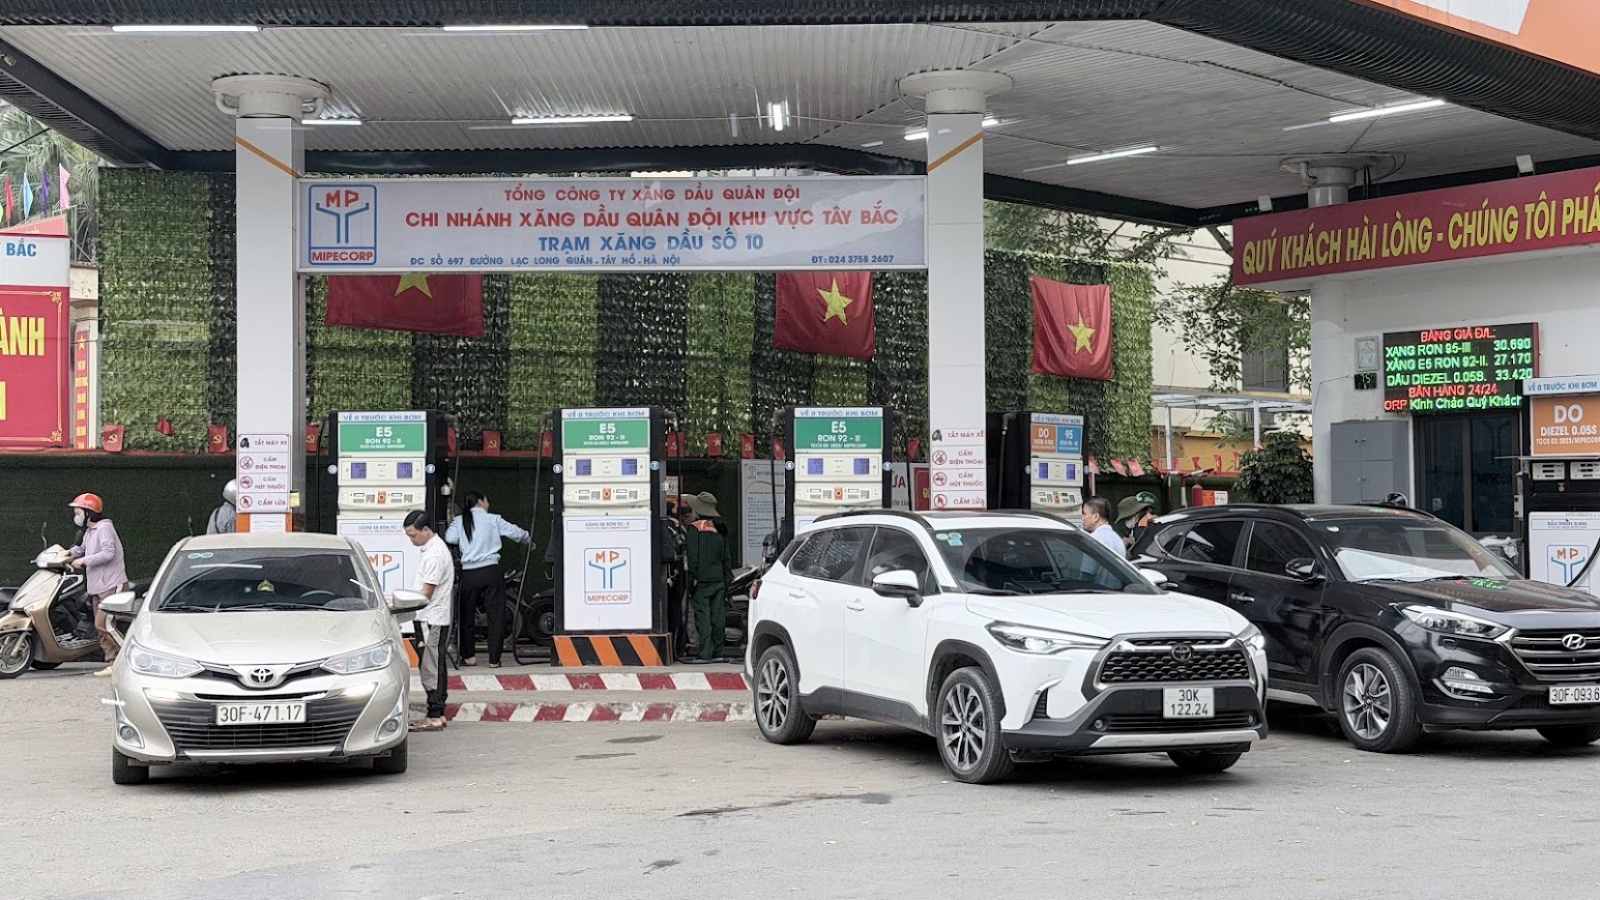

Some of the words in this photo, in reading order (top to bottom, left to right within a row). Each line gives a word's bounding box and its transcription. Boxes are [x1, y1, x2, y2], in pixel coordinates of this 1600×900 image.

[505, 183, 545, 201] TỔNG
[555, 187, 601, 201] CÔNG
[609, 189, 626, 200] TY
[632, 187, 675, 200] XĂNG
[685, 181, 713, 200] DẦU
[723, 184, 765, 200] QUÂN
[773, 184, 800, 202] ĐỘI
[405, 212, 439, 227] CHI
[447, 207, 512, 227] NHÁNH
[519, 209, 575, 227] XĂNG
[583, 203, 619, 227] DẦU
[626, 208, 679, 227] QUÂN
[688, 208, 722, 230] ĐỘI
[729, 211, 766, 226] KHU
[775, 209, 814, 229] VỰC
[823, 206, 852, 225] TÂY
[861, 200, 899, 225] BẮC
[1243, 227, 1277, 275] QUÝ
[1281, 222, 1341, 270] KHÁCH
[1346, 214, 1376, 262] HÀI
[1382, 210, 1433, 259] LÒNG
[1448, 198, 1519, 250] CHÚNG
[1525, 191, 1556, 240] TÔI
[538, 237, 590, 254] TRẠM
[600, 232, 656, 251] XĂNG
[667, 228, 703, 250] DẦU
[711, 227, 737, 250] SỐ
[745, 235, 764, 250] 10
[6, 238, 37, 257] BẮC
[312, 251, 373, 261] MIPECORP
[410, 257, 426, 265] ĐC
[430, 254, 443, 265] SỐ
[448, 257, 464, 265] 697
[470, 254, 504, 265] ĐƯỜNG
[511, 257, 530, 267] LẠC
[534, 257, 559, 265] LONG
[663, 255, 680, 266] NỘI
[872, 255, 894, 263] 2607
[1418, 344, 1443, 356] RON
[1445, 342, 1471, 354] 95-III
[1493, 338, 1531, 350] 30.690
[1418, 358, 1432, 370] E5
[1434, 356, 1460, 369] RON
[1494, 353, 1531, 366] 27.170
[1412, 372, 1452, 385] DIEZEL
[1495, 368, 1533, 381] 33.420
[1468, 383, 1498, 395] 24/24
[1410, 398, 1433, 410] Kính
[1466, 395, 1487, 409] Quý
[1554, 404, 1583, 423] DO
[376, 427, 393, 437] E5
[599, 423, 616, 434] E5
[831, 421, 847, 433] E5
[1039, 428, 1049, 438] DO
[1541, 426, 1569, 436] DIEZEL
[1571, 425, 1597, 435] 0.05S
[1065, 429, 1074, 440] 95
[953, 497, 971, 505] CẤM
[587, 594, 629, 602] MIPECORP
[1178, 689, 1199, 701] 30K
[220, 705, 302, 722] 30F-471.17
[1171, 704, 1208, 716] 122.24
